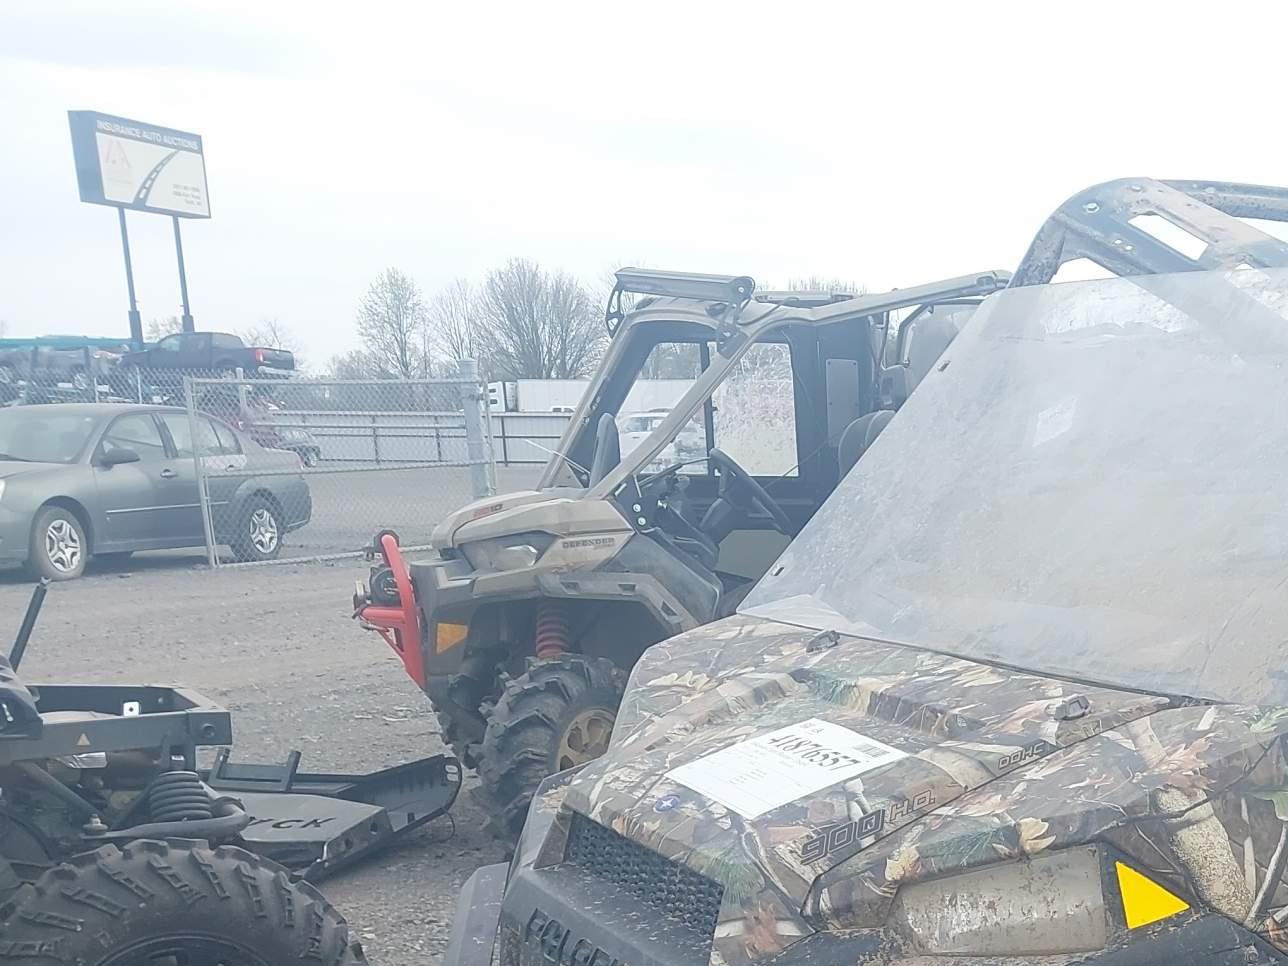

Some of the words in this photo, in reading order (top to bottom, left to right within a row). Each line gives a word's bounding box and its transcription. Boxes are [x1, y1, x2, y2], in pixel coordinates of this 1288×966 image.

[562, 537, 615, 549] DEFENDER
[768, 734, 861, 771] 41876557
[800, 809, 885, 865] 900
